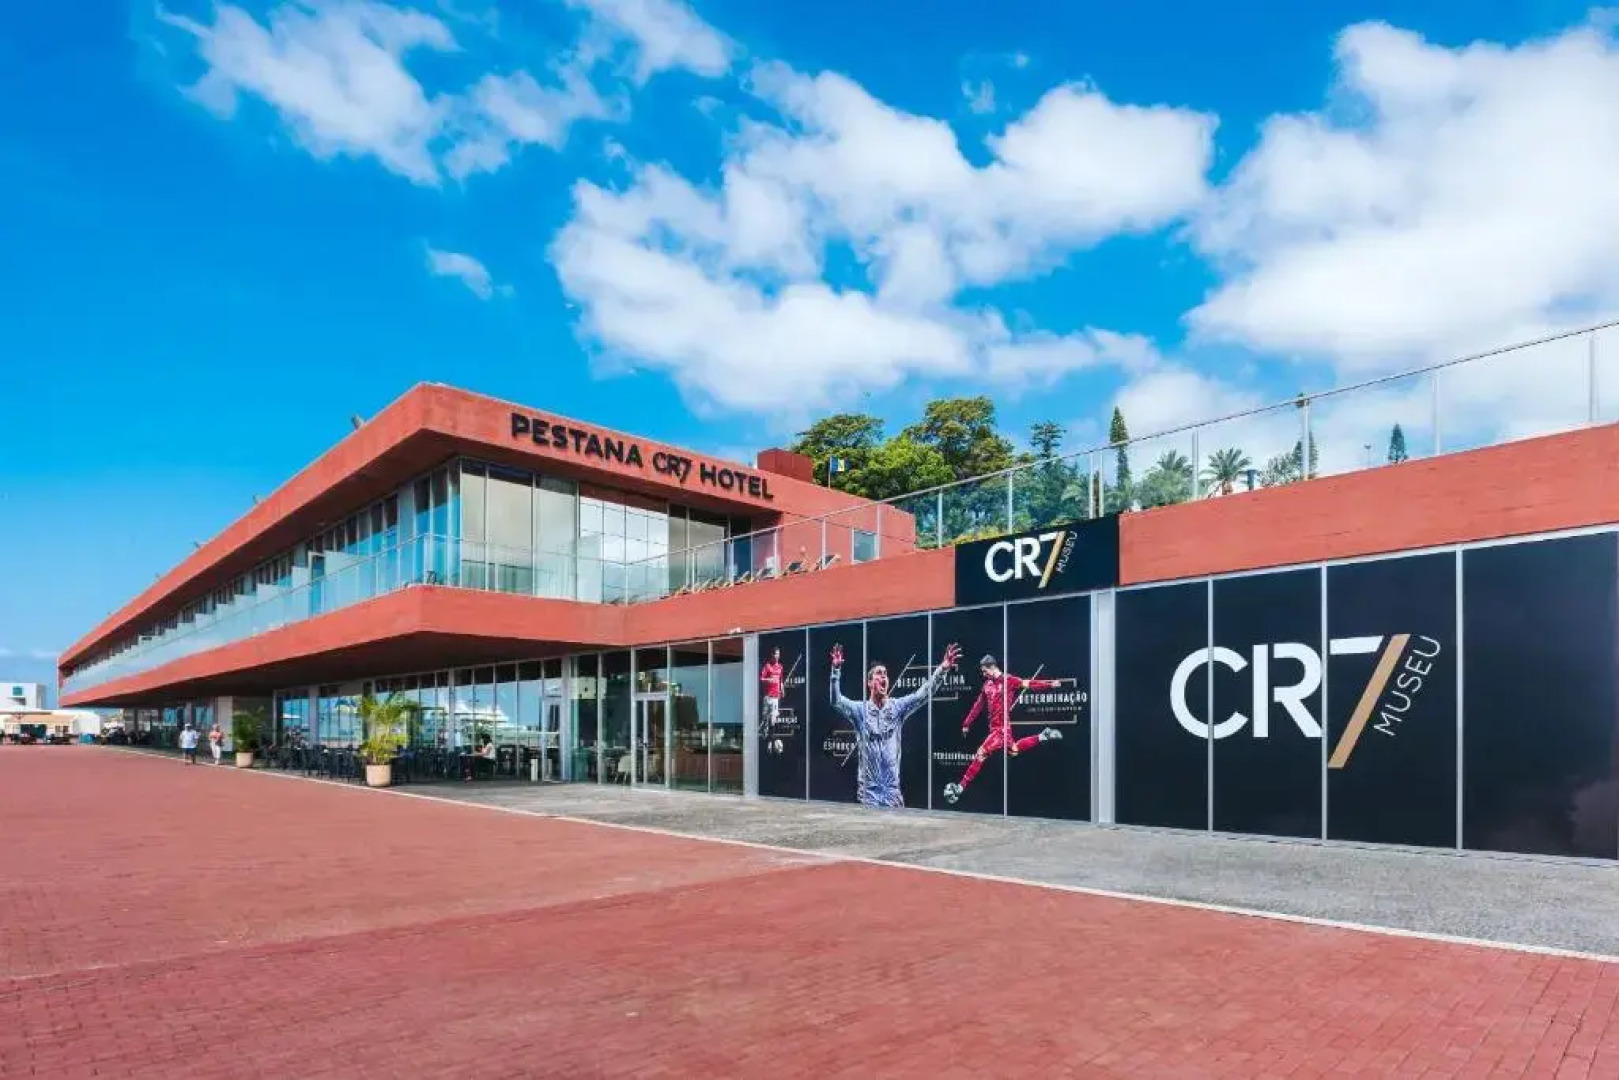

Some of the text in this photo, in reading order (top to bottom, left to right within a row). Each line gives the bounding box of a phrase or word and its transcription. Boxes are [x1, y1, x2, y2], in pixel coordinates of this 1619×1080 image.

[510, 412, 774, 500] PESTANA CR7 HOTEL
[984, 530, 1067, 589] CR7
[1055, 530, 1078, 573] MUSEU
[1019, 690, 1087, 705] DETERMINAÇÃO
[1170, 633, 1411, 769] CR7
[1373, 635, 1441, 736] MUSEU
